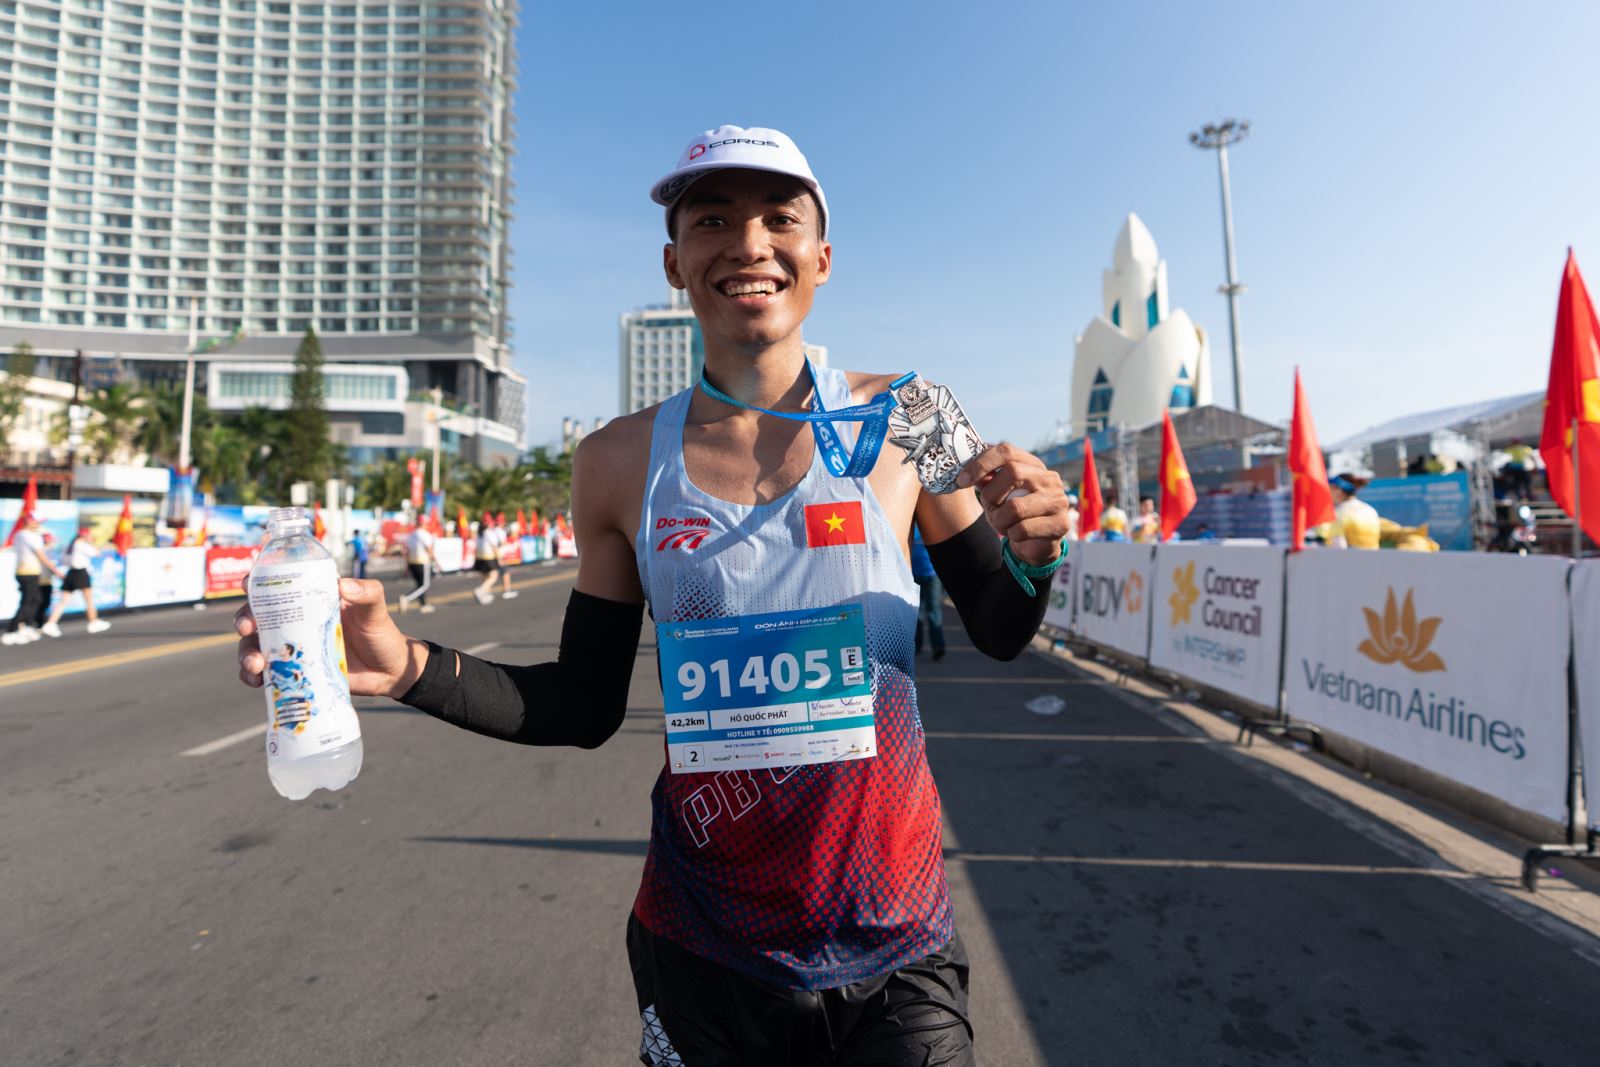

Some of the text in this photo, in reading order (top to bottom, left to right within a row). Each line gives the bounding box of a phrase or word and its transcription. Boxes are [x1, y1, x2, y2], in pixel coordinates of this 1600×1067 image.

[709, 138, 779, 149] COROS
[1204, 566, 1261, 600] Cancer
[1083, 573, 1125, 621] BIDV
[1202, 598, 1262, 638] Council
[848, 654, 856, 666] E
[677, 648, 832, 701] 91405
[1302, 658, 1527, 760] Vietnam Airlines
[743, 711, 767, 722] QUỐC
[767, 710, 788, 721] PHÁT
[671, 718, 705, 728] 42,2km
[727, 730, 756, 738] HOTLINE
[690, 751, 698, 762] 2
